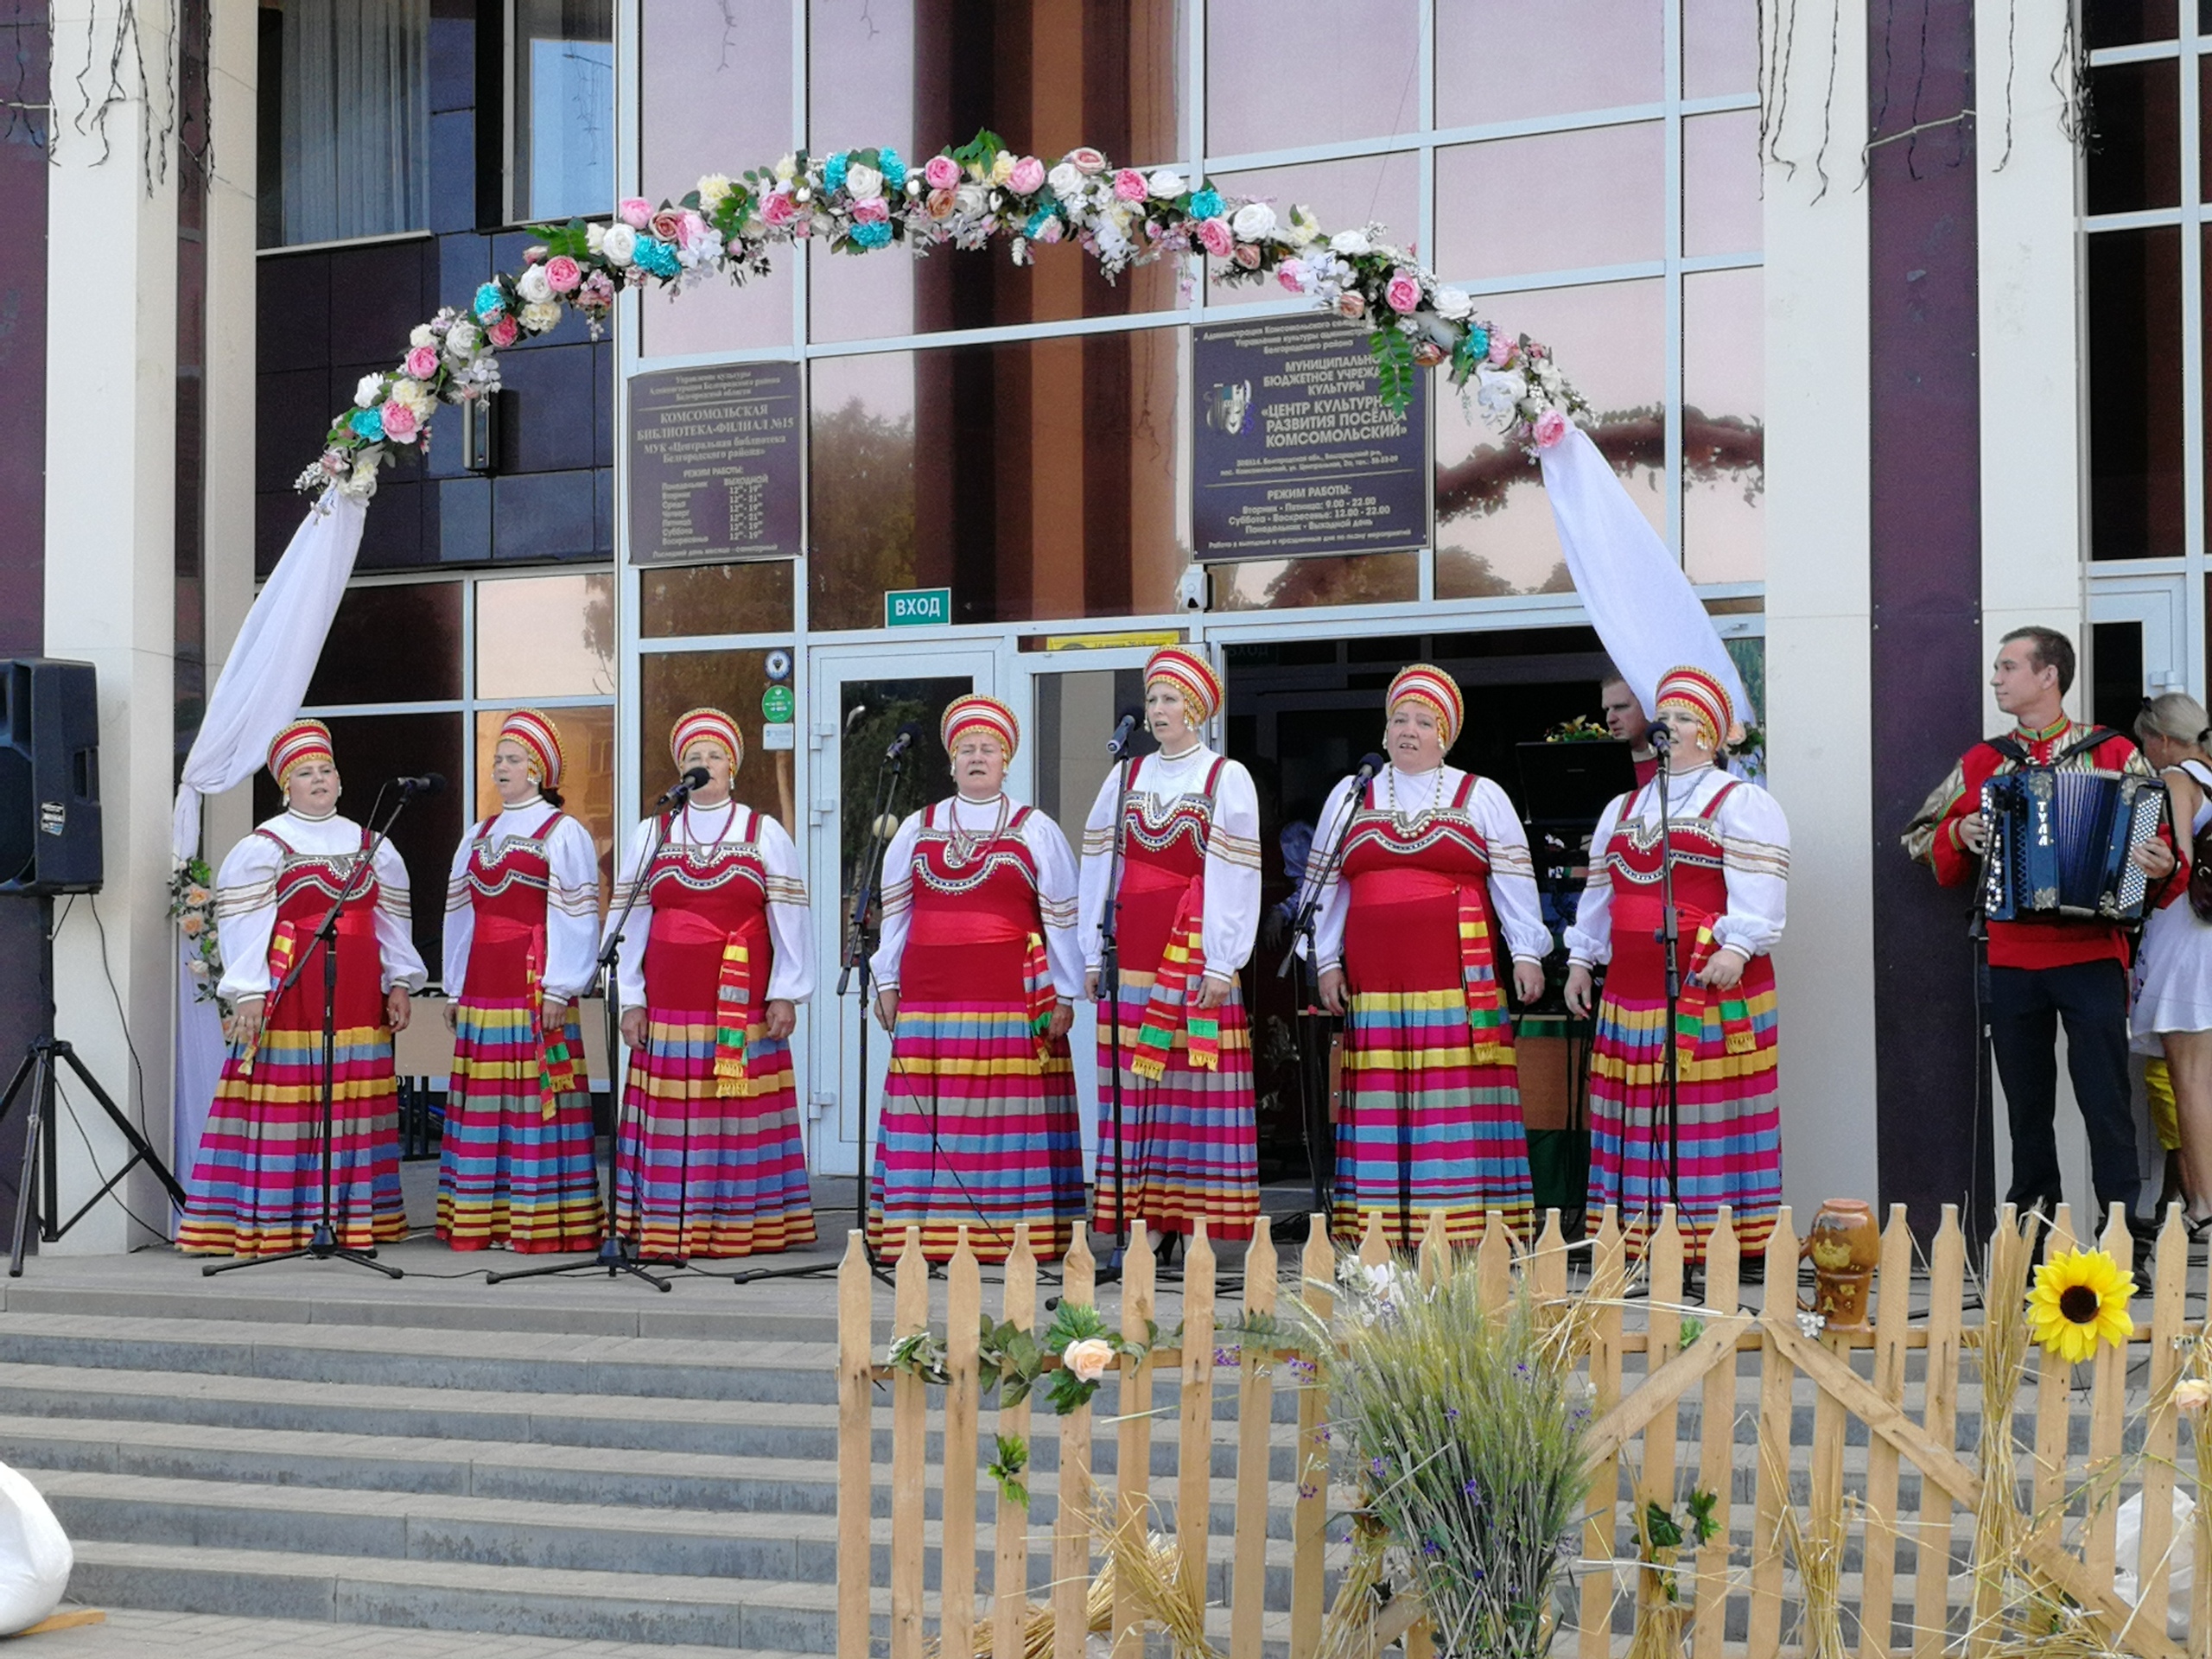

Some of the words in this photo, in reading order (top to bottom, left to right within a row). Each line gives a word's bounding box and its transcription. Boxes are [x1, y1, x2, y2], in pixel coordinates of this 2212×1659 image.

[1263, 370, 1334, 387] БЮДЖЕТНОЕ
[1307, 380, 1365, 396] КУЛЬТУРЫ
[660, 404, 768, 424] КОМСОМОЛЬСКАЯ
[1262, 401, 1311, 418] «ЦЕНТР
[637, 419, 771, 442] БИБЛИОТЕКА-ФИЛИАЛ
[1266, 414, 1336, 432] РАЗВИТИЯ
[1266, 422, 1408, 448] КОМСОМОЛЬСКИЙ»
[1267, 488, 1306, 501] РЕЖИМ
[1307, 484, 1352, 499] РАБОТЫ:
[1325, 499, 1344, 509] 9.00
[1351, 496, 1376, 507] 22.00
[1366, 505, 1390, 517] 22.00
[895, 597, 940, 619] ВХОД
[2037, 802, 2048, 846] ТУЛА
